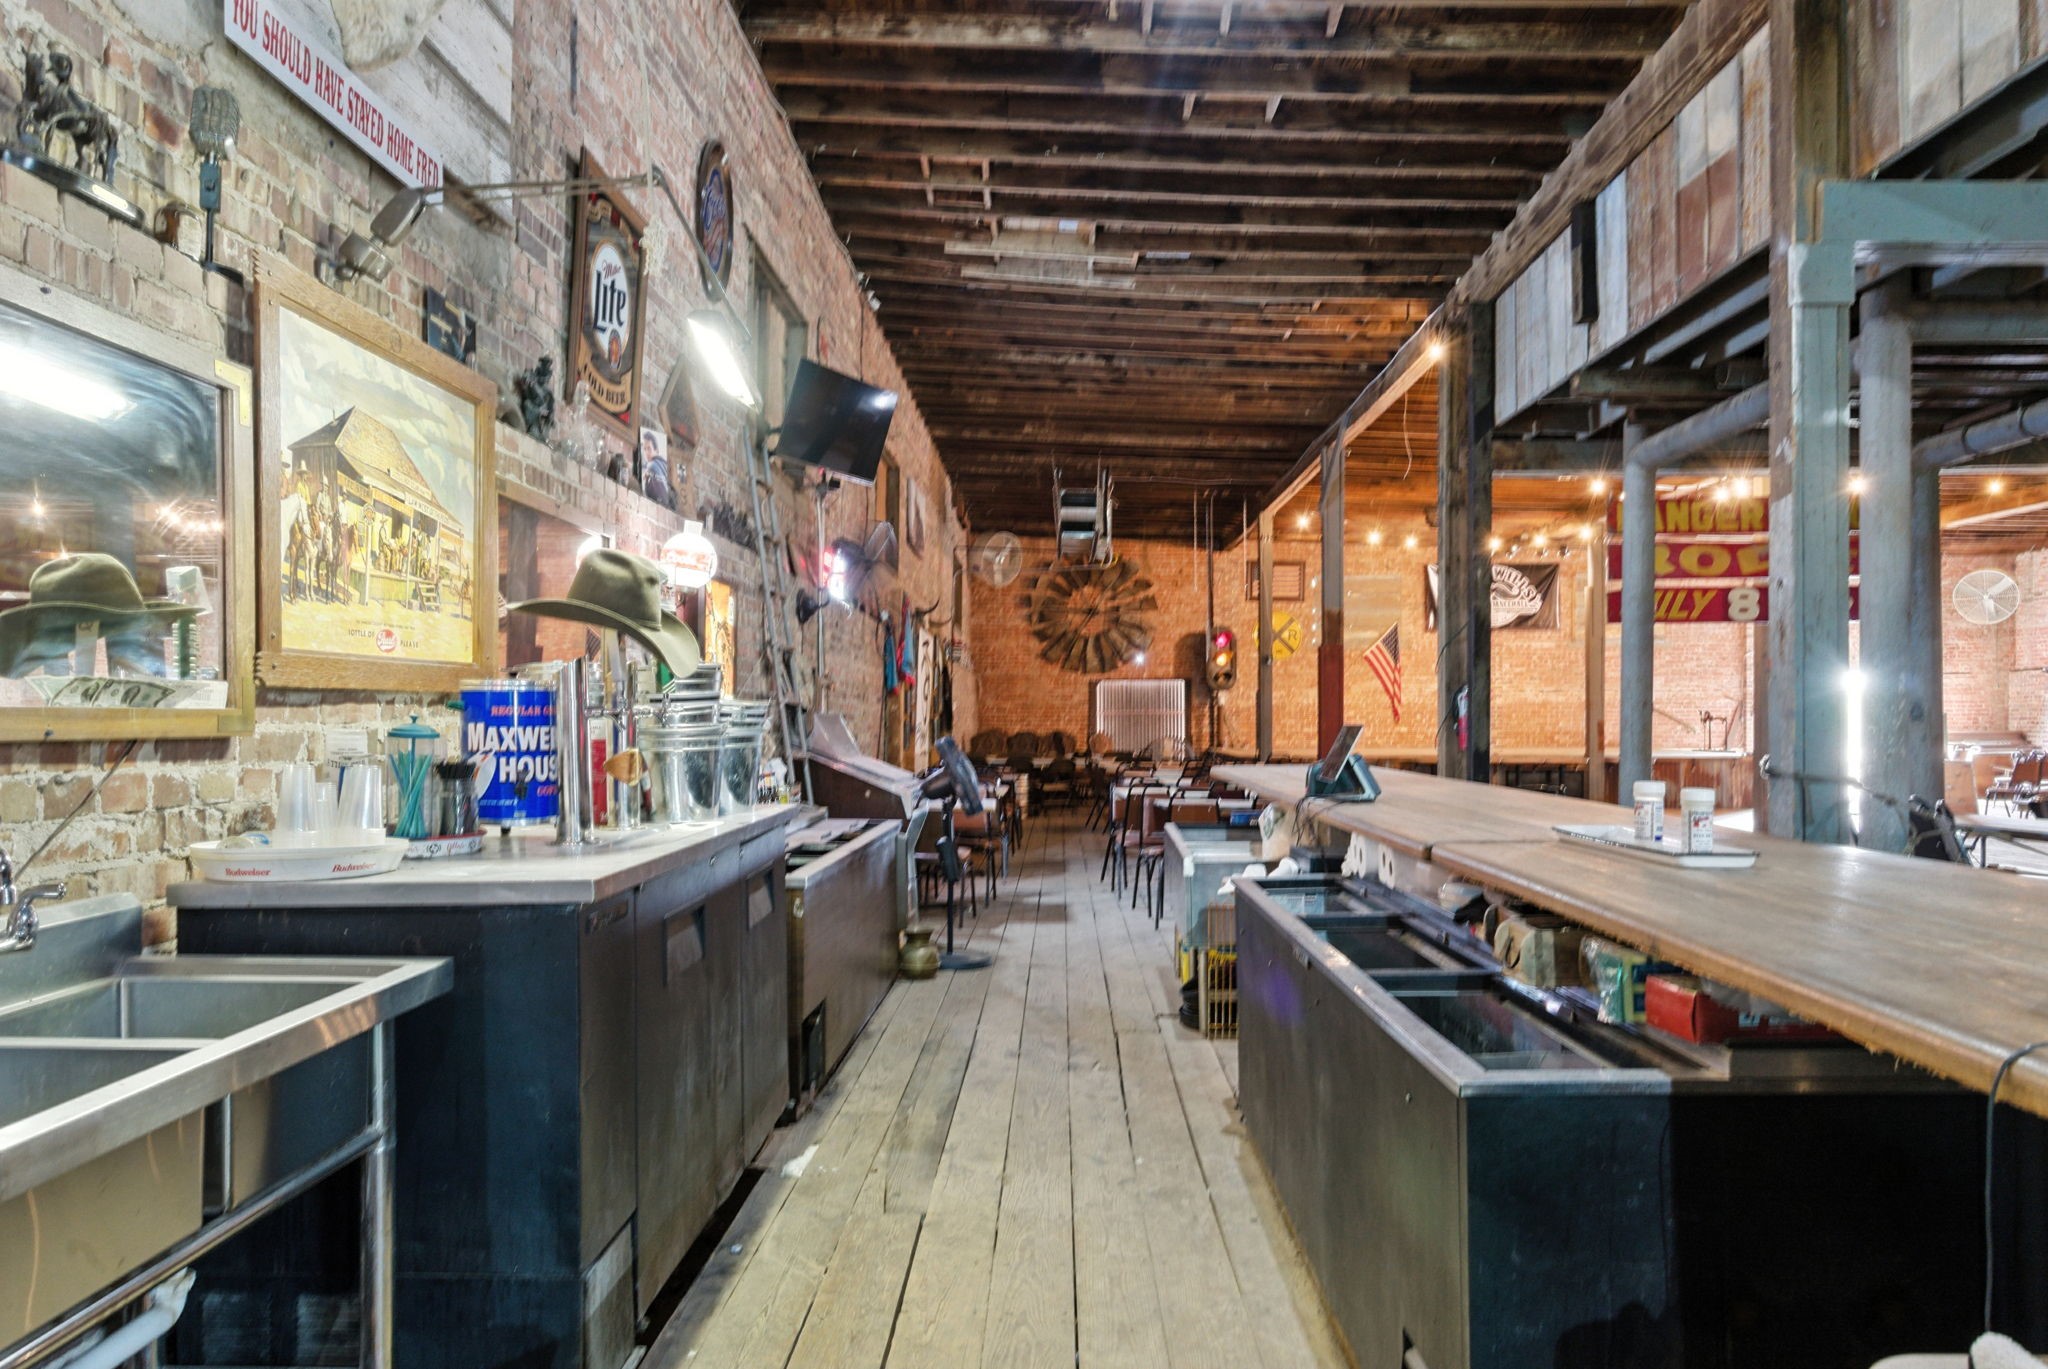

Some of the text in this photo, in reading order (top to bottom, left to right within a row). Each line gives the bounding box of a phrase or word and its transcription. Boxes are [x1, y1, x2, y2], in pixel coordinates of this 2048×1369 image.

[233, 0, 439, 191] YOU SHOULD HAVE STAYED HOME FRED
[593, 269, 627, 333] Lite
[605, 388, 626, 405] BEER
[1728, 588, 1760, 621] 8
[400, 640, 419, 649] PLEASE
[491, 705, 541, 717] REGULAR
[225, 868, 271, 876] Budweiser
[332, 863, 375, 873] Budweiser
